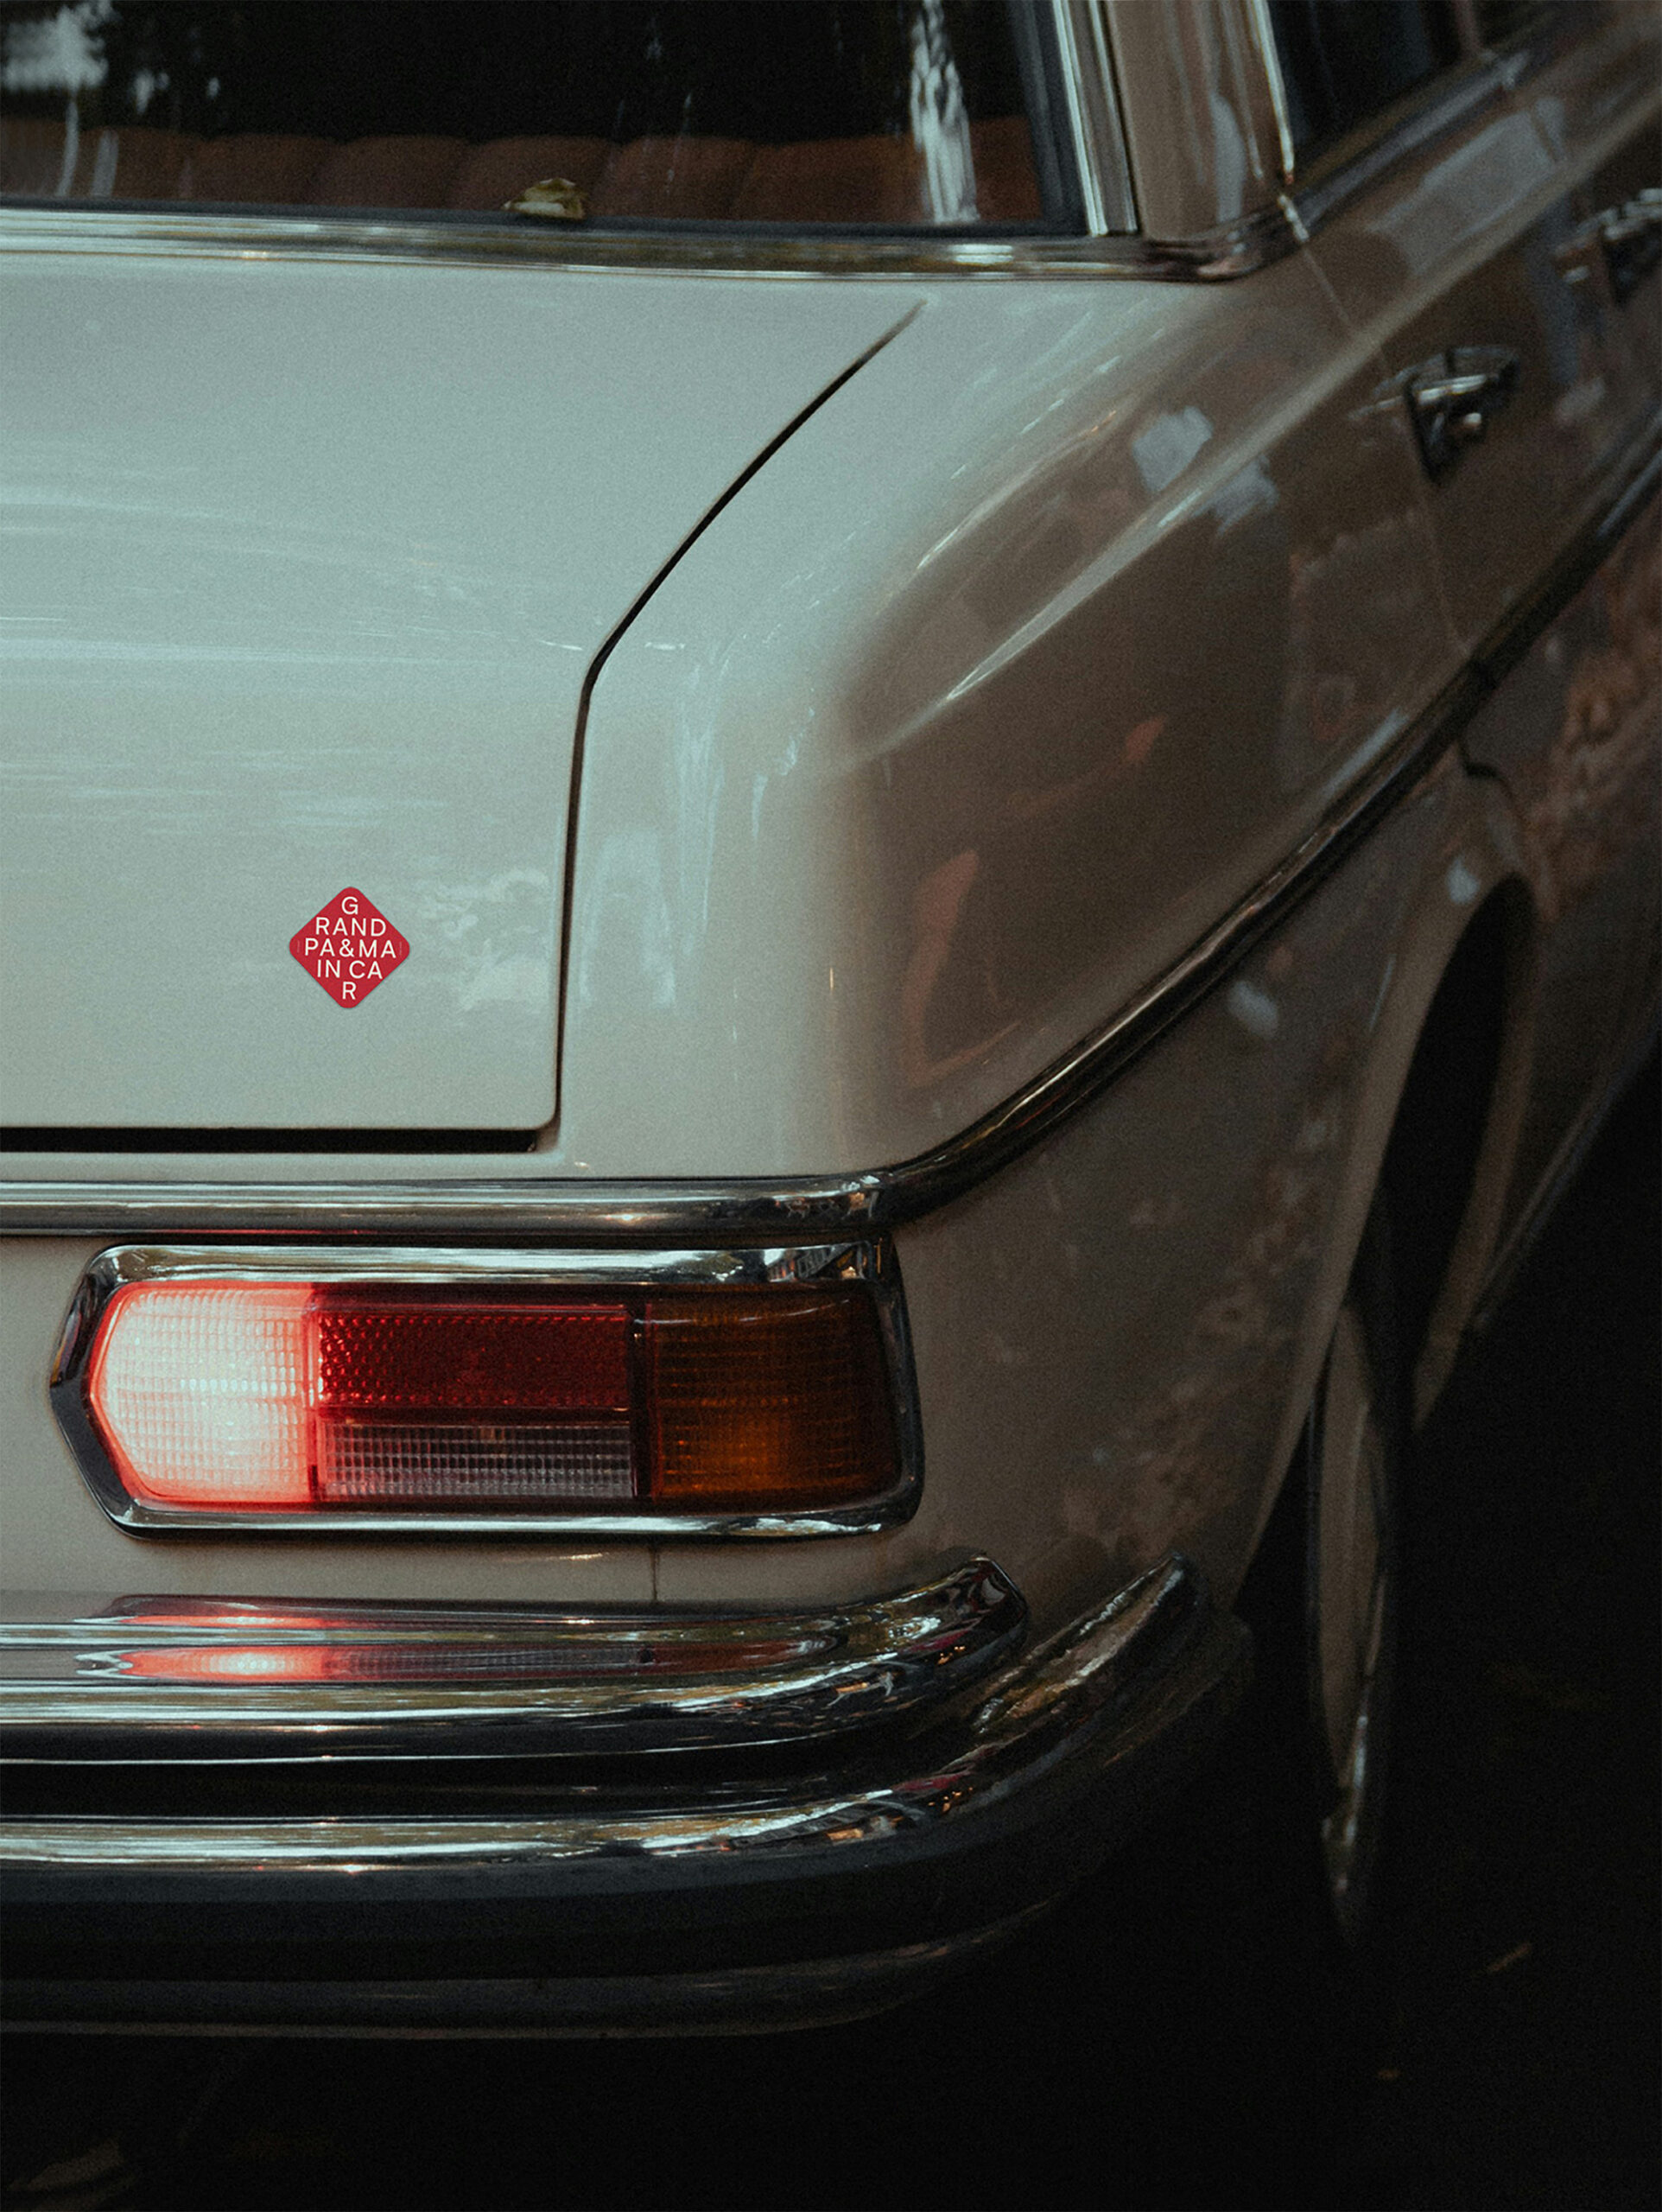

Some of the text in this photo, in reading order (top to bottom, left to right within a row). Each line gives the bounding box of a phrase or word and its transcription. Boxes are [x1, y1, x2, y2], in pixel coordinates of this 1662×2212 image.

[341, 896, 358, 915] G
[315, 917, 386, 937] RAND
[305, 938, 396, 959] PA&MA
[317, 959, 383, 979] IN CA
[342, 981, 357, 1001] R
